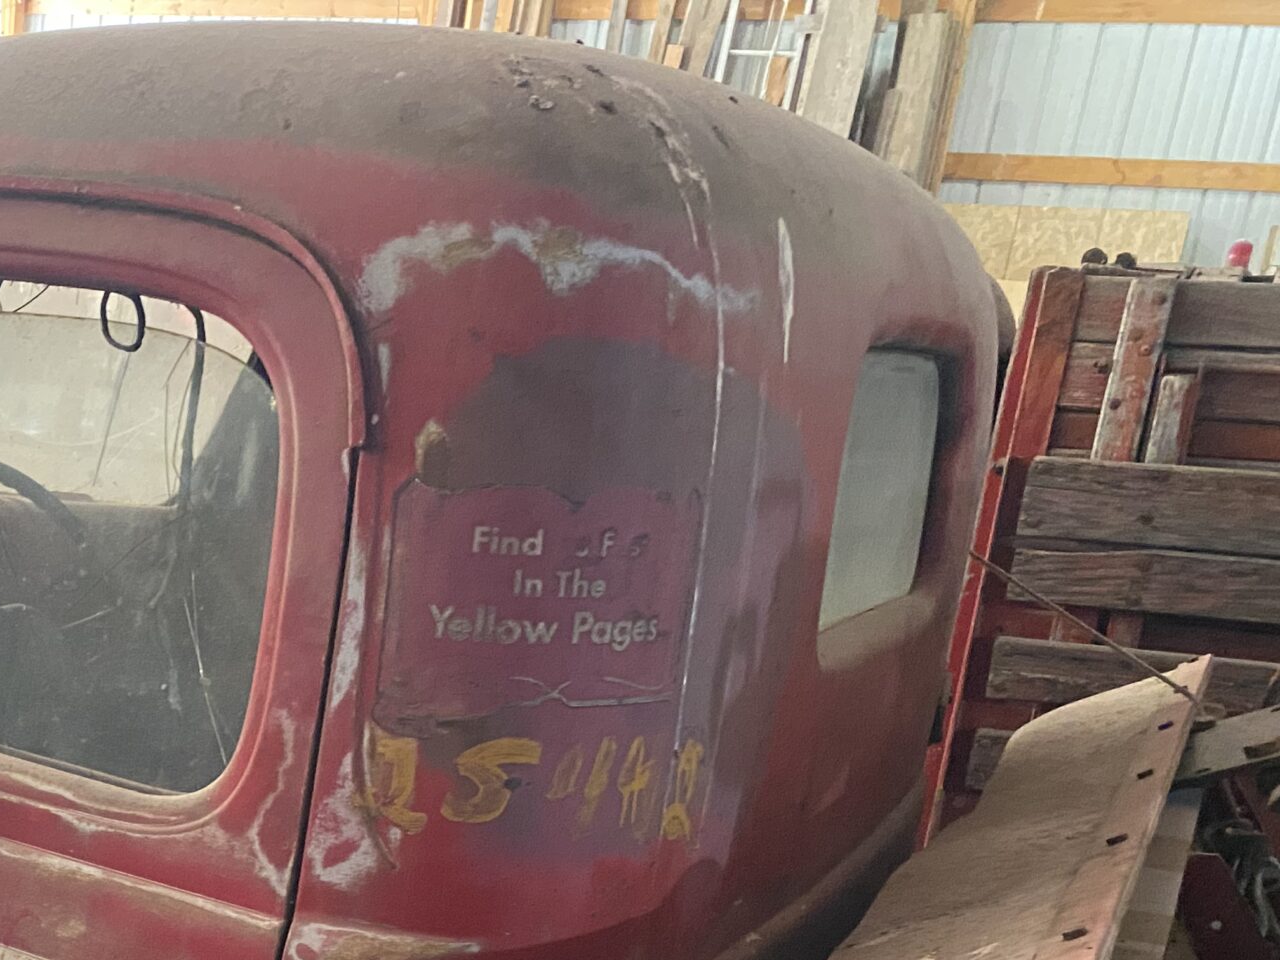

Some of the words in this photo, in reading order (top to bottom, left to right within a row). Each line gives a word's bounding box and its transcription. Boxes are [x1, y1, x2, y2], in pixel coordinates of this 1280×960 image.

[471, 526, 544, 556] Find
[513, 569, 543, 598] In
[555, 568, 607, 598] The
[428, 604, 559, 644] Yellow
[570, 611, 658, 651] Pages
